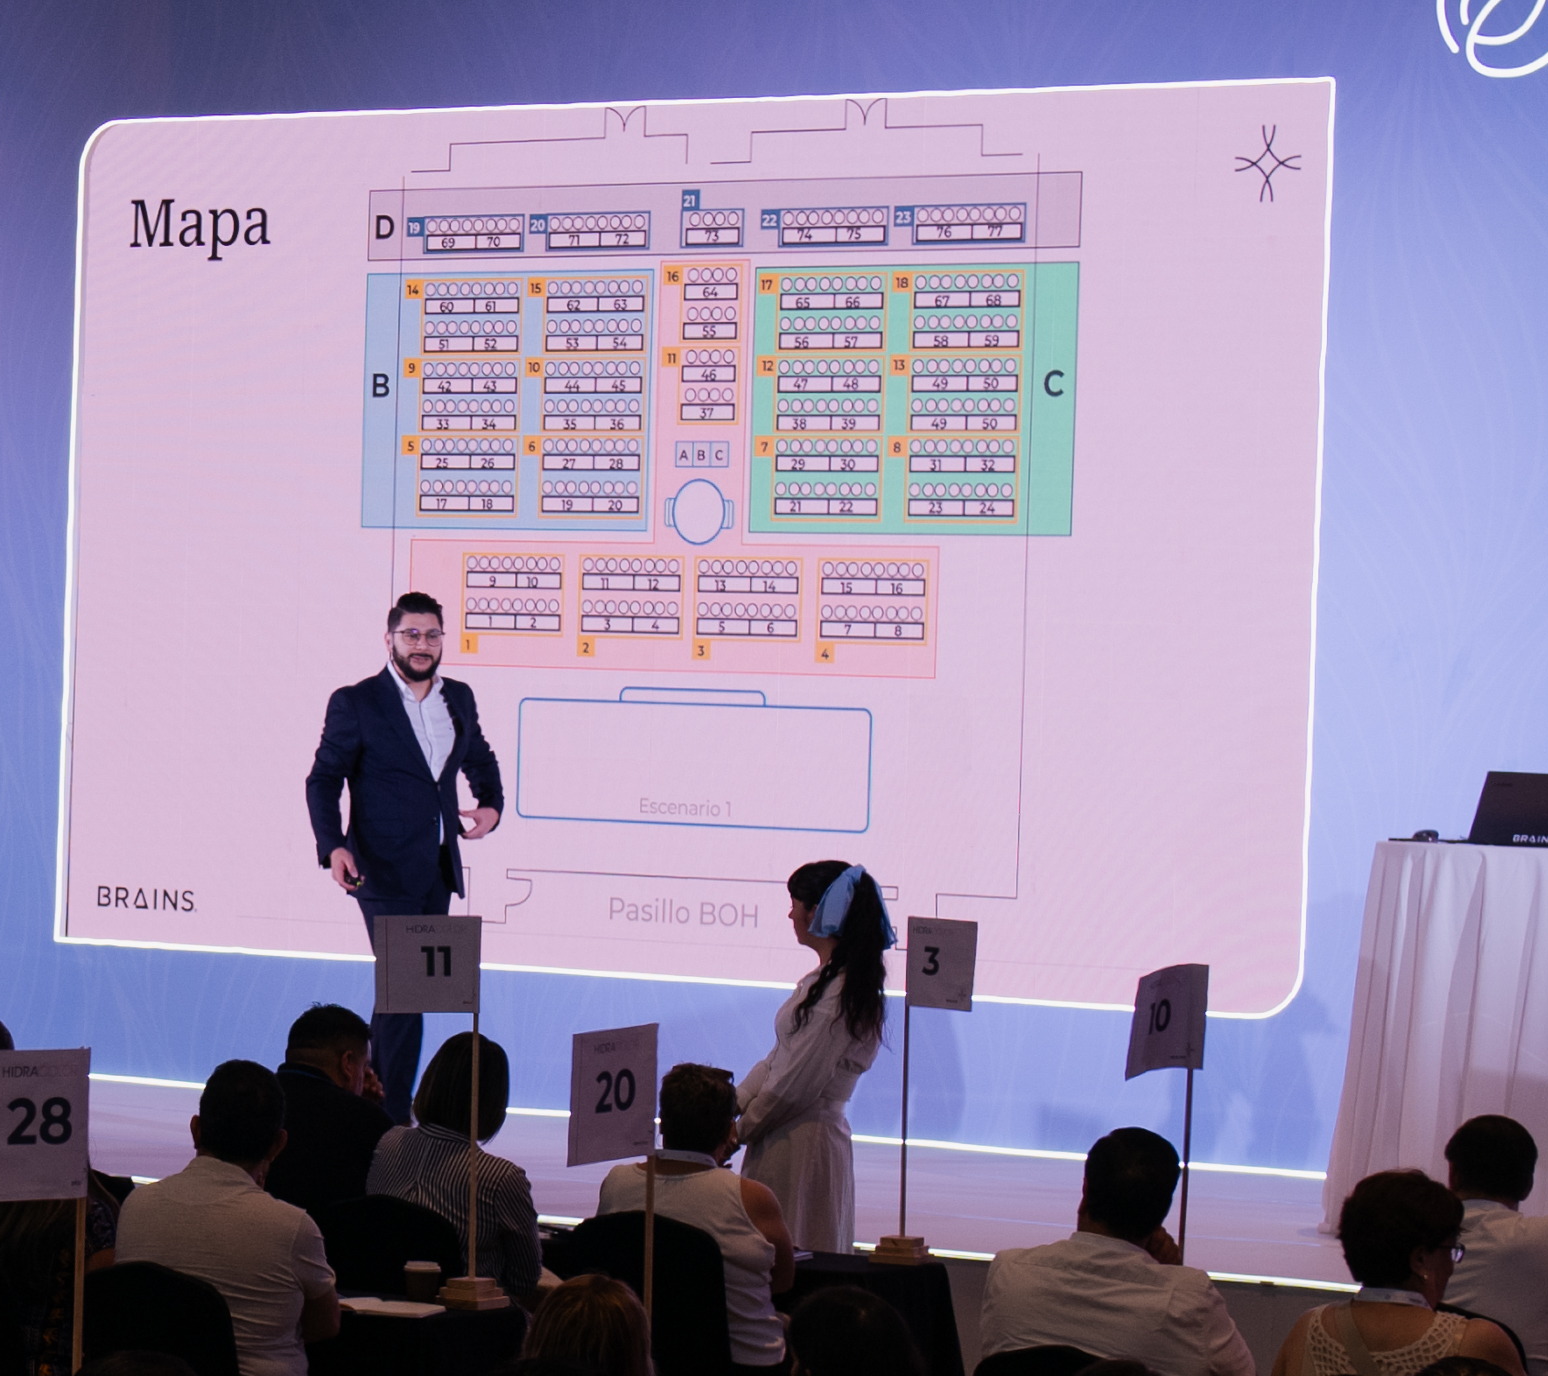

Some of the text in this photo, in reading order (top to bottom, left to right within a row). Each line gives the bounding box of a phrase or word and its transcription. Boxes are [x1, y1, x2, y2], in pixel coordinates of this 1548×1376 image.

[683, 195, 695, 207] 21
[762, 215, 777, 226] 22
[896, 211, 911, 223] 23
[129, 199, 272, 262] Mapa
[375, 215, 395, 239] D
[408, 222, 420, 233] 19
[530, 220, 545, 232] 20
[987, 225, 1002, 236] 77
[705, 230, 719, 242] 73
[797, 228, 812, 242] 74
[846, 228, 862, 240] 75
[936, 226, 952, 238] 76
[442, 236, 455, 248] 69
[487, 235, 500, 247] 70
[568, 235, 580, 246] 71
[615, 233, 630, 245] 72
[667, 272, 678, 282] 16
[896, 277, 908, 288] 18
[407, 285, 419, 295] 14
[531, 283, 541, 293] 15
[762, 280, 772, 290] 17
[703, 287, 717, 298] 64
[567, 300, 580, 311] 62
[614, 300, 627, 311] 63
[796, 298, 810, 308] 65
[846, 297, 860, 307] 66
[935, 296, 949, 307] 67
[986, 295, 1001, 306] 68
[440, 302, 454, 312] 60
[485, 302, 496, 312] 61
[703, 326, 716, 337] 55
[439, 339, 448, 350] 51
[484, 339, 496, 350] 52
[566, 338, 578, 349] 53
[613, 338, 626, 349] 54
[795, 337, 809, 348] 56
[845, 337, 857, 347] 57
[934, 336, 948, 347] 58
[985, 336, 999, 346] 59
[667, 354, 676, 364] 11
[409, 364, 415, 373] 9
[529, 362, 540, 372] 10
[762, 361, 773, 371] 12
[894, 360, 905, 370] 13
[701, 369, 716, 380] 46
[372, 374, 390, 397] B
[438, 381, 452, 392] 42
[483, 381, 496, 392] 43
[565, 381, 580, 392] 44
[612, 381, 625, 391] 45
[794, 379, 808, 390] 47
[843, 379, 858, 390] 48
[932, 378, 948, 389] 49
[983, 378, 998, 389] 50
[1044, 370, 1064, 396] C
[700, 408, 713, 419] 37
[436, 419, 449, 429] 33
[482, 419, 496, 429] 34
[563, 419, 576, 430] 35
[610, 419, 624, 430] 36
[792, 419, 806, 430] 38
[842, 419, 856, 429] 39
[932, 419, 947, 430] 49
[982, 419, 997, 429] 50
[408, 442, 414, 451] 5
[529, 442, 535, 452] 6
[761, 442, 768, 452] 7
[894, 442, 901, 452] 8
[679, 450, 688, 460] A
[698, 450, 705, 460] B
[715, 450, 723, 460] C
[436, 458, 448, 468] 25
[481, 458, 494, 468] 26
[563, 459, 575, 469] 27
[610, 459, 623, 469] 28
[791, 459, 805, 470] 29
[841, 459, 855, 470] 30
[930, 460, 942, 471] 31
[981, 460, 995, 471] 32
[436, 499, 447, 509] 17
[482, 499, 492, 510] 18
[562, 500, 573, 510] 19
[608, 500, 622, 511] 20
[790, 502, 801, 512] 21
[839, 502, 853, 512] 22
[929, 503, 942, 513] 23
[980, 503, 995, 513] 24
[489, 576, 496, 587] 9
[527, 577, 538, 588] 10
[601, 578, 609, 588] 11
[648, 579, 658, 589] 12
[715, 580, 726, 591] 13
[763, 581, 776, 591] 14
[841, 583, 852, 593] 15
[891, 583, 903, 594] 16
[530, 618, 537, 628] 2
[604, 619, 610, 628] 3
[651, 620, 659, 630] 4
[719, 622, 725, 632] 5
[767, 623, 774, 633] 6
[844, 625, 851, 634] 7
[895, 626, 902, 636] 8
[582, 642, 589, 653] 2
[697, 646, 704, 656] 3
[821, 649, 829, 659] 4
[639, 797, 732, 817] Escenario 1
[97, 886, 195, 912] BRAINS
[609, 897, 759, 930] Pasillo BOH
[421, 946, 451, 976] 11
[922, 946, 939, 975] 3
[1148, 999, 1171, 1035] 10
[595, 1069, 635, 1113] 20
[7, 1097, 72, 1145] 28
